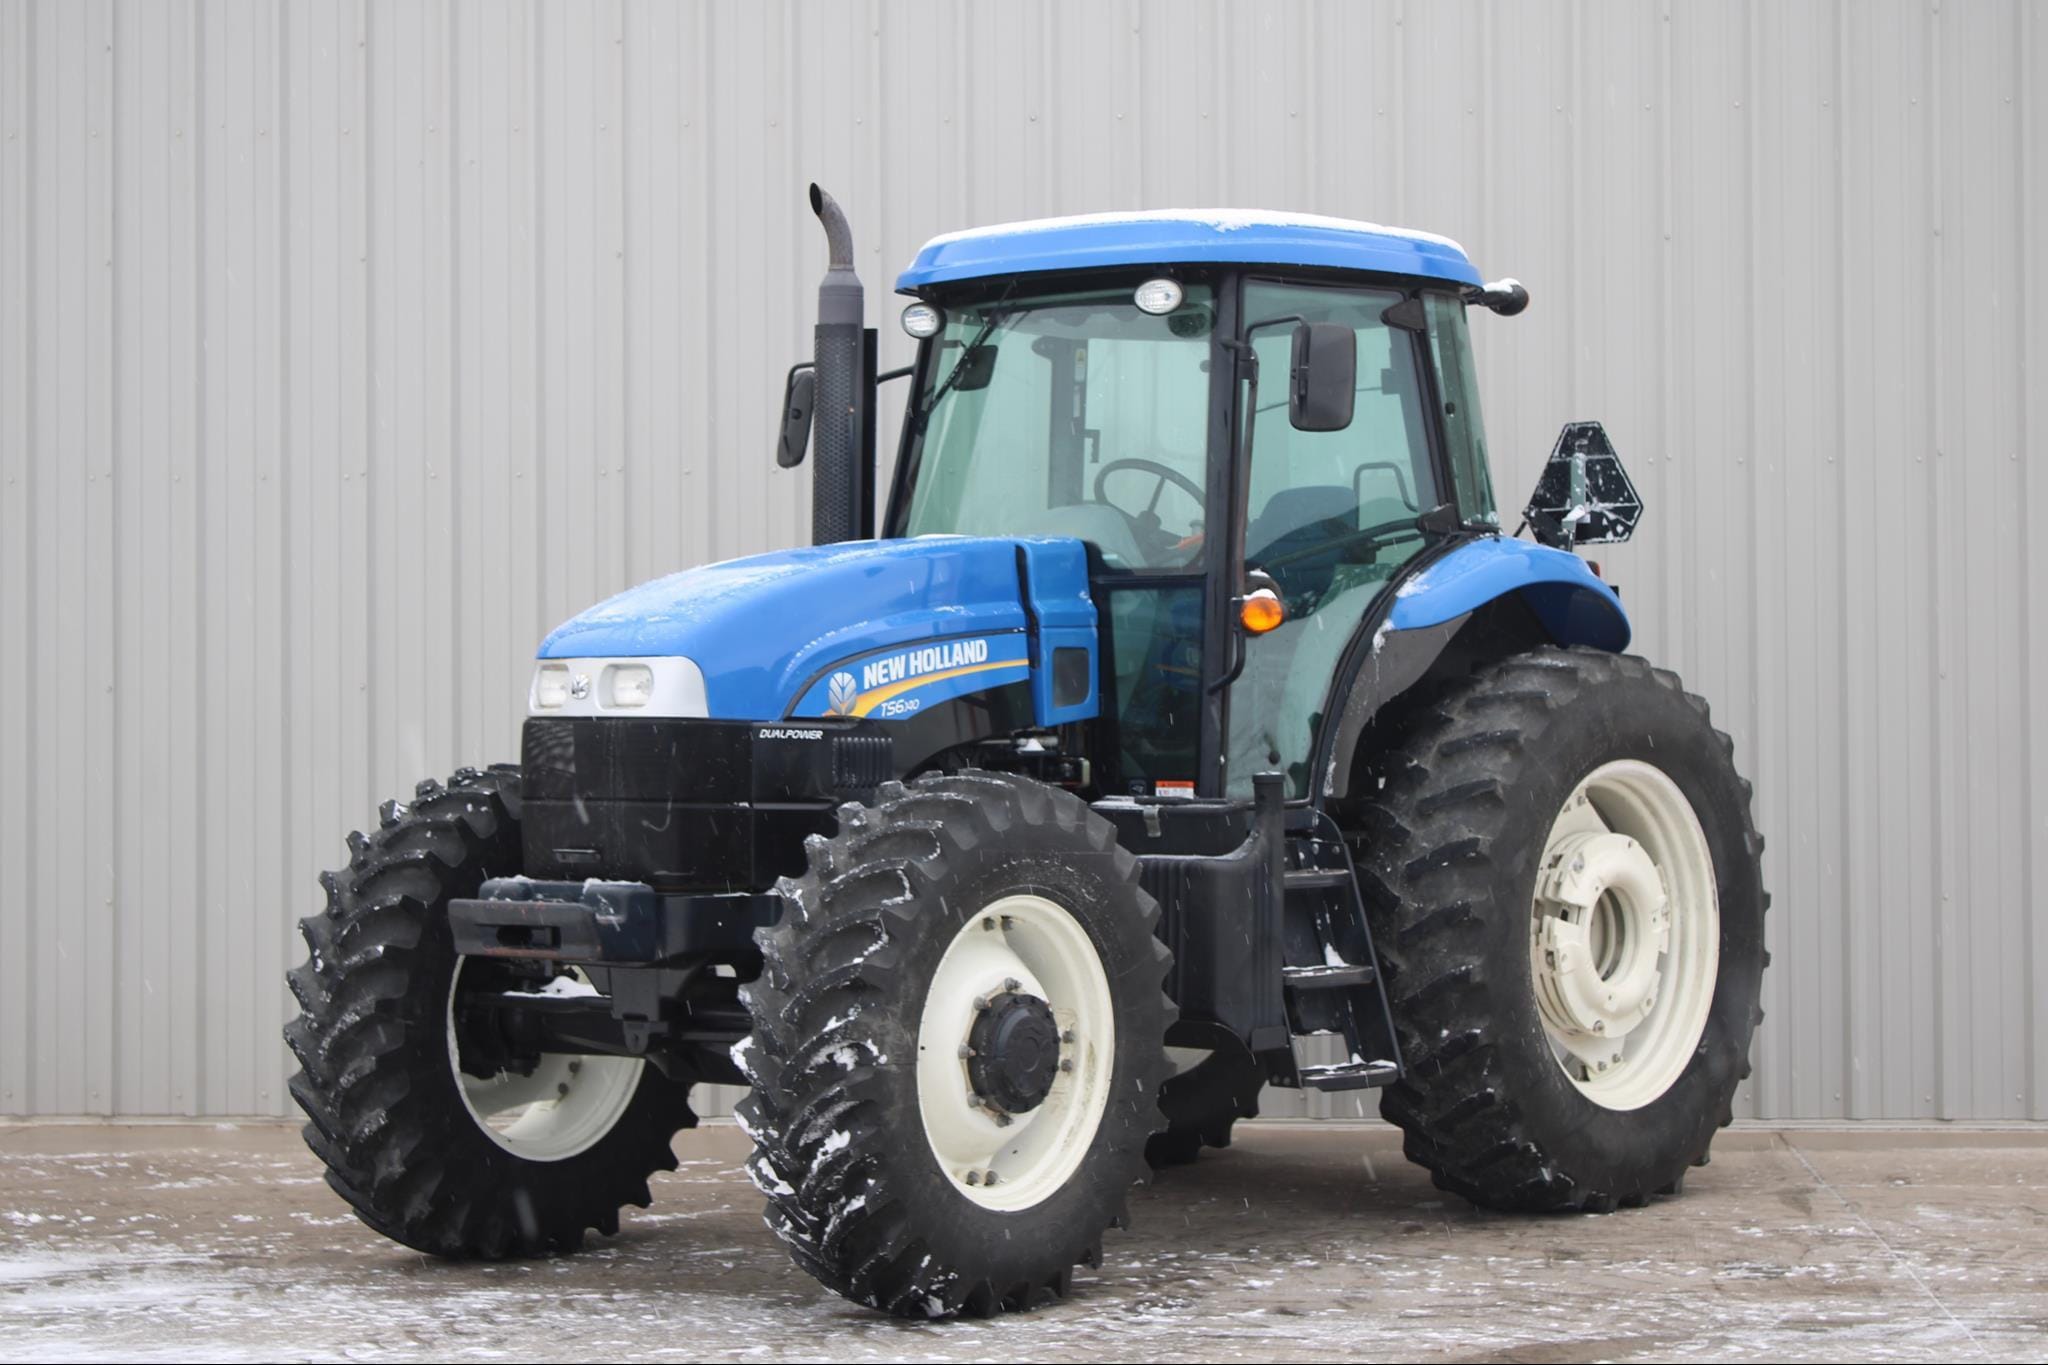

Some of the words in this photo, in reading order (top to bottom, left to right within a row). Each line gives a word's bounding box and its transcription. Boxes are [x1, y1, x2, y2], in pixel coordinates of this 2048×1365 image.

[864, 656, 906, 689] NEW
[909, 639, 988, 674] HOLLAND
[759, 728, 824, 740] DUALPOWER
